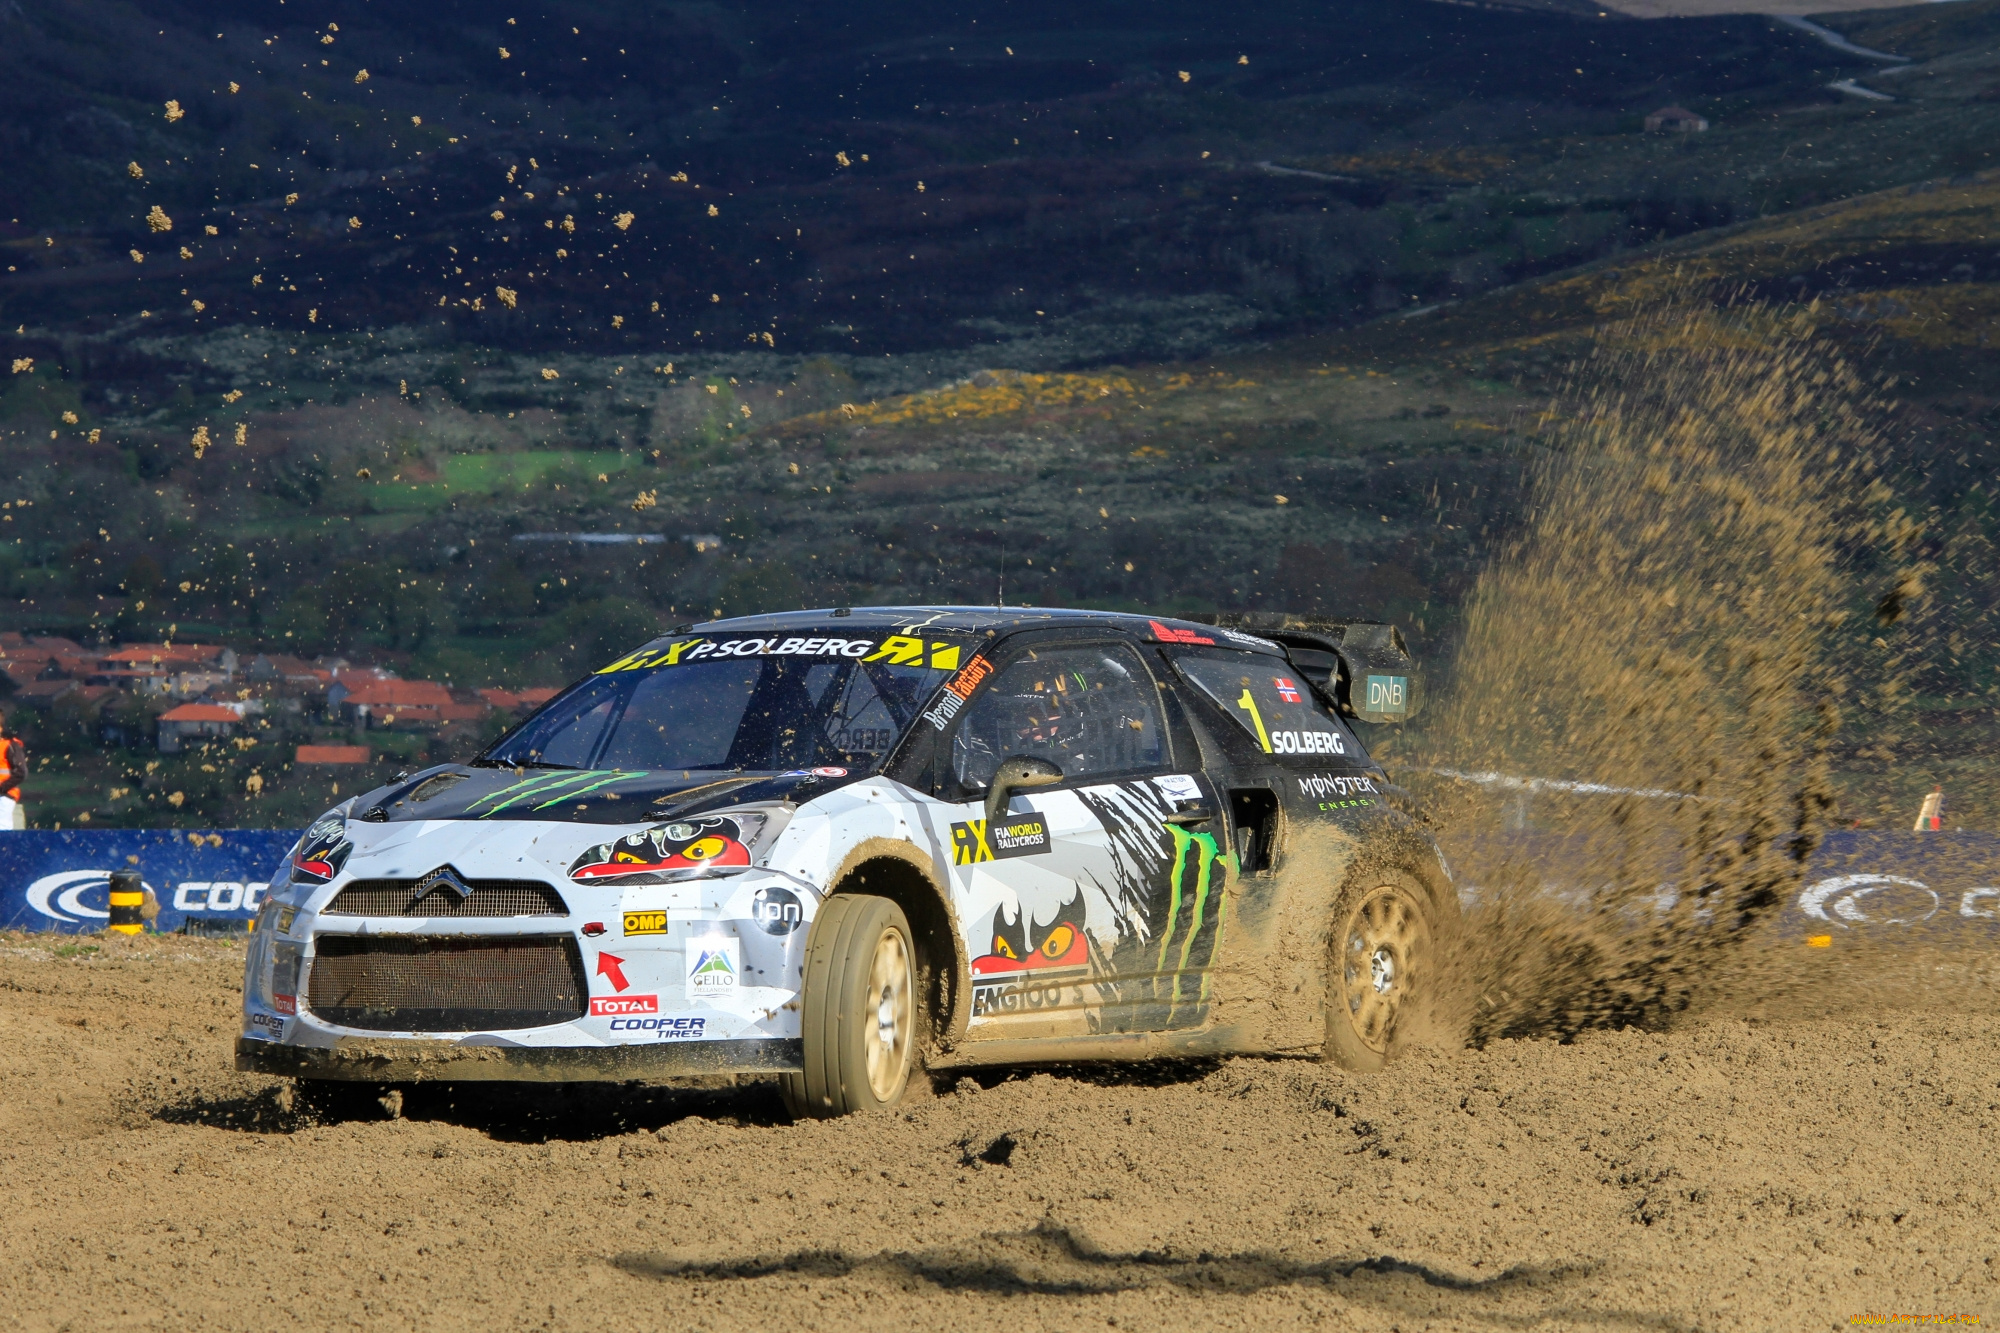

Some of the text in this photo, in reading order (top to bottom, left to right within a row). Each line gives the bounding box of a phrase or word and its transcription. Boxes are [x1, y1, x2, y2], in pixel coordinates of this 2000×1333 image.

[1371, 676, 1402, 712] DNB
[1237, 689, 1273, 754] 1
[1272, 731, 1344, 754] SOLBERG
[1319, 799, 1377, 811] ENERGY
[997, 834, 1044, 849] RALLYCROSS
[755, 889, 800, 922] ion
[624, 914, 667, 931] OMP
[693, 975, 734, 986] GEILO
[275, 996, 295, 1012] TOTAL
[593, 1000, 656, 1013] TOTAL
[253, 1013, 284, 1029] COOPER
[610, 1018, 706, 1031] COOPER
[656, 1030, 703, 1038] TIRES
